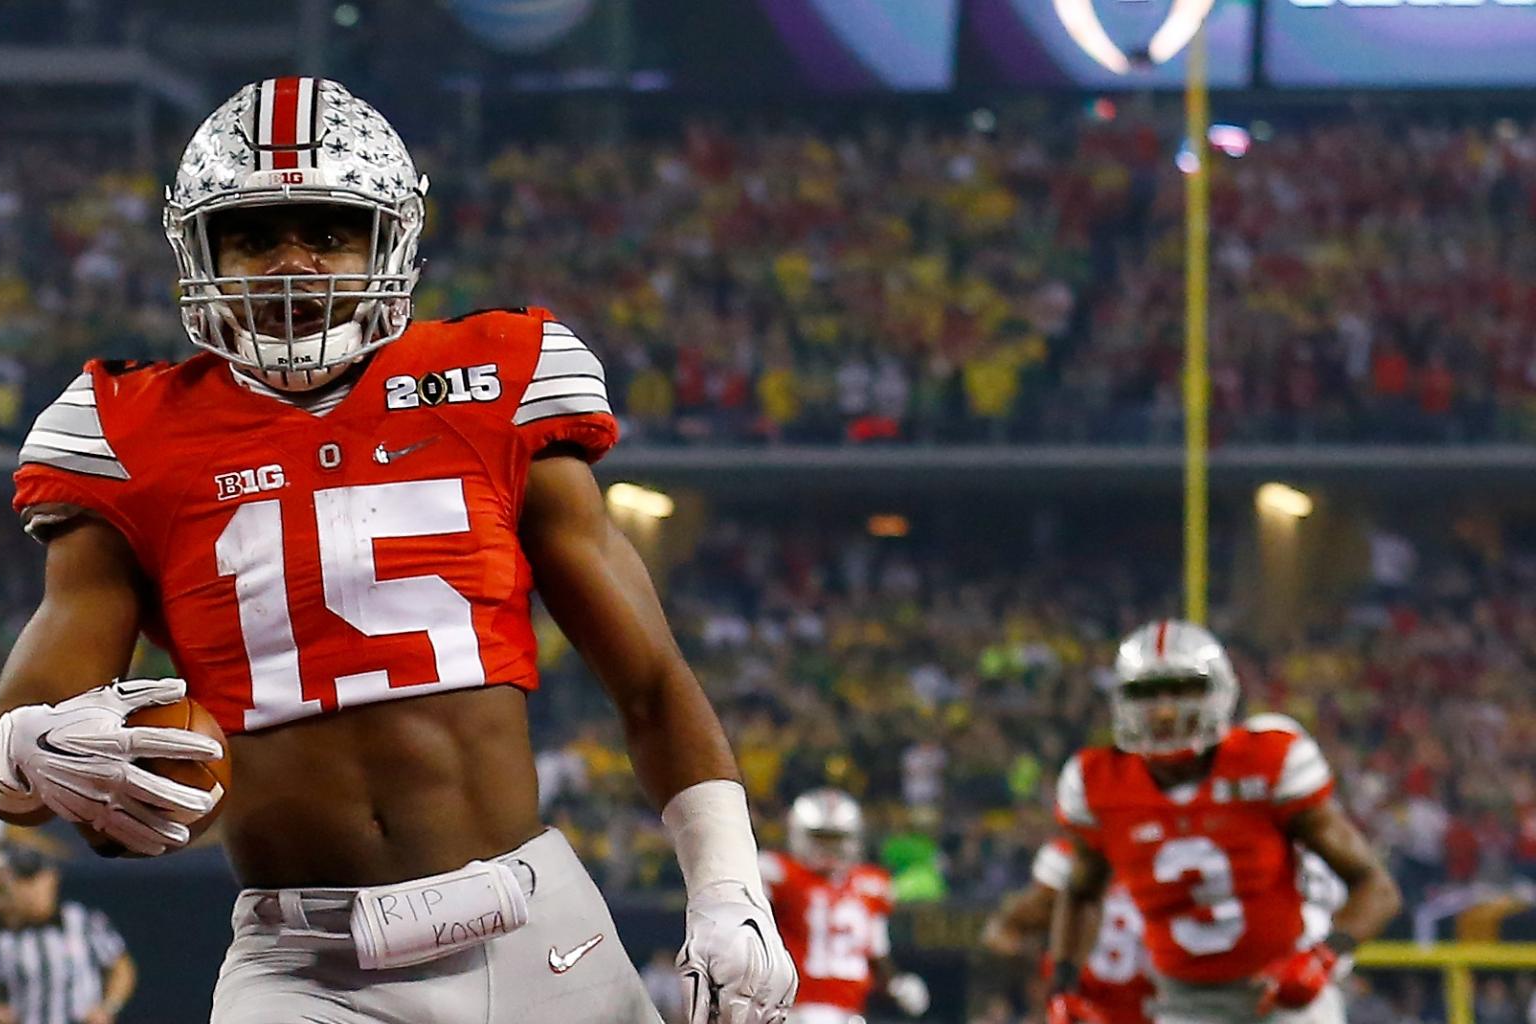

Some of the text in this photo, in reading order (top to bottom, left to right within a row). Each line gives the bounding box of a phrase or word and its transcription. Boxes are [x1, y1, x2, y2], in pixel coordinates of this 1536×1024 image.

[385, 363, 502, 411] 2015
[215, 478, 486, 732] 15
[377, 888, 444, 926] RIP
[432, 910, 507, 948] KOSTA
[1153, 836, 1245, 957] 3
[805, 886, 870, 979] 12
